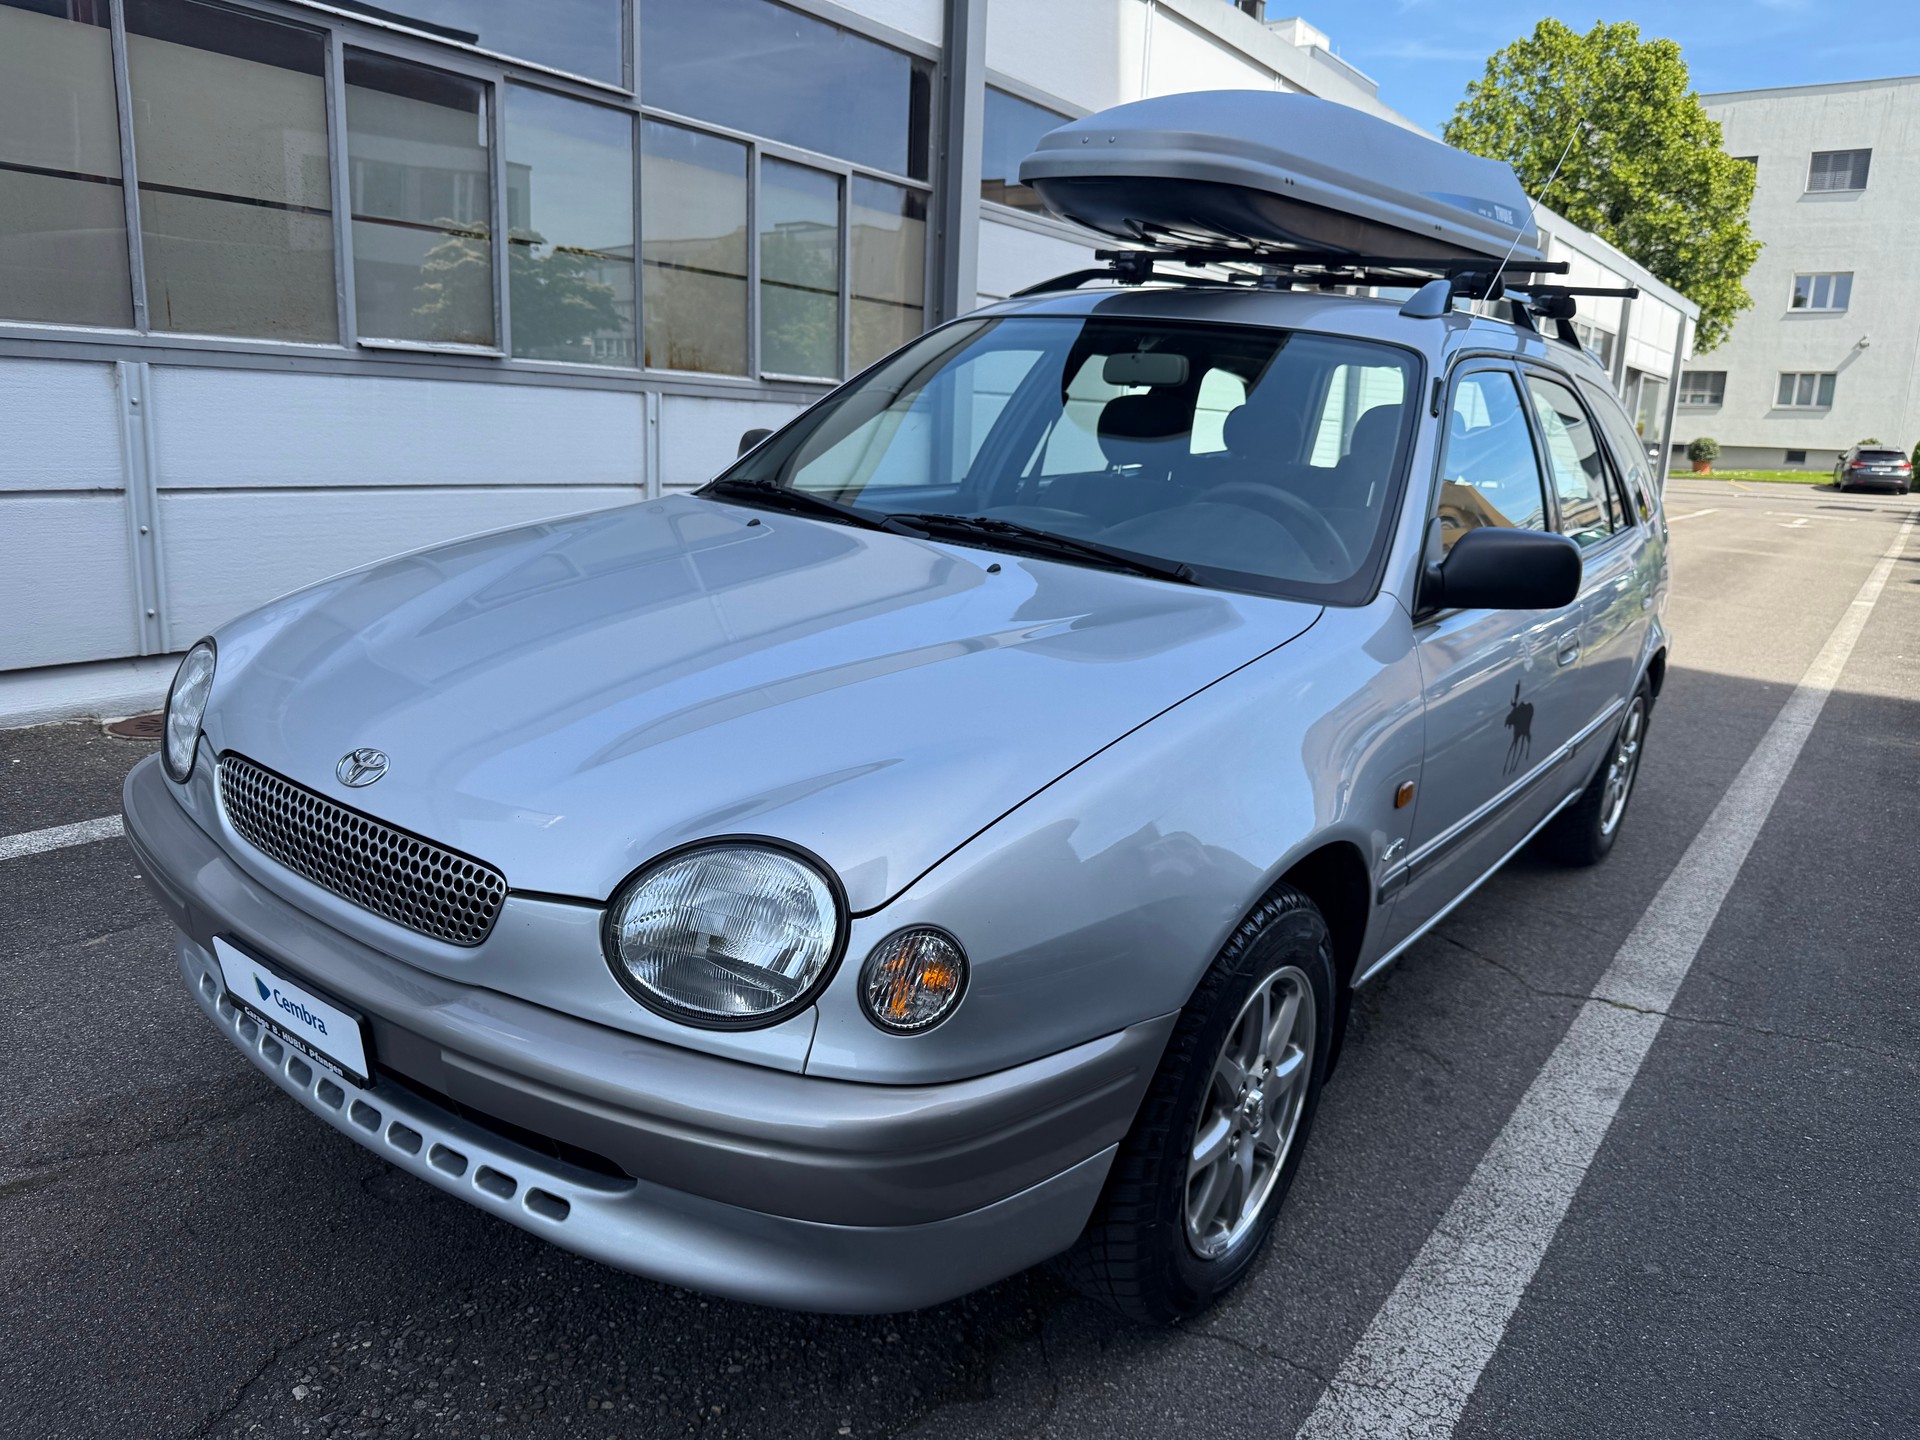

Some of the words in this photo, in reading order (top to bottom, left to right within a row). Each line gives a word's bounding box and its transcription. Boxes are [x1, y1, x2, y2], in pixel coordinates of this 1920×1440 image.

[244, 1006, 270, 1030] Garage
[271, 1024, 281, 1037] B.
[309, 1048, 344, 1077] Pfungen
[273, 988, 328, 1036] Cembra
